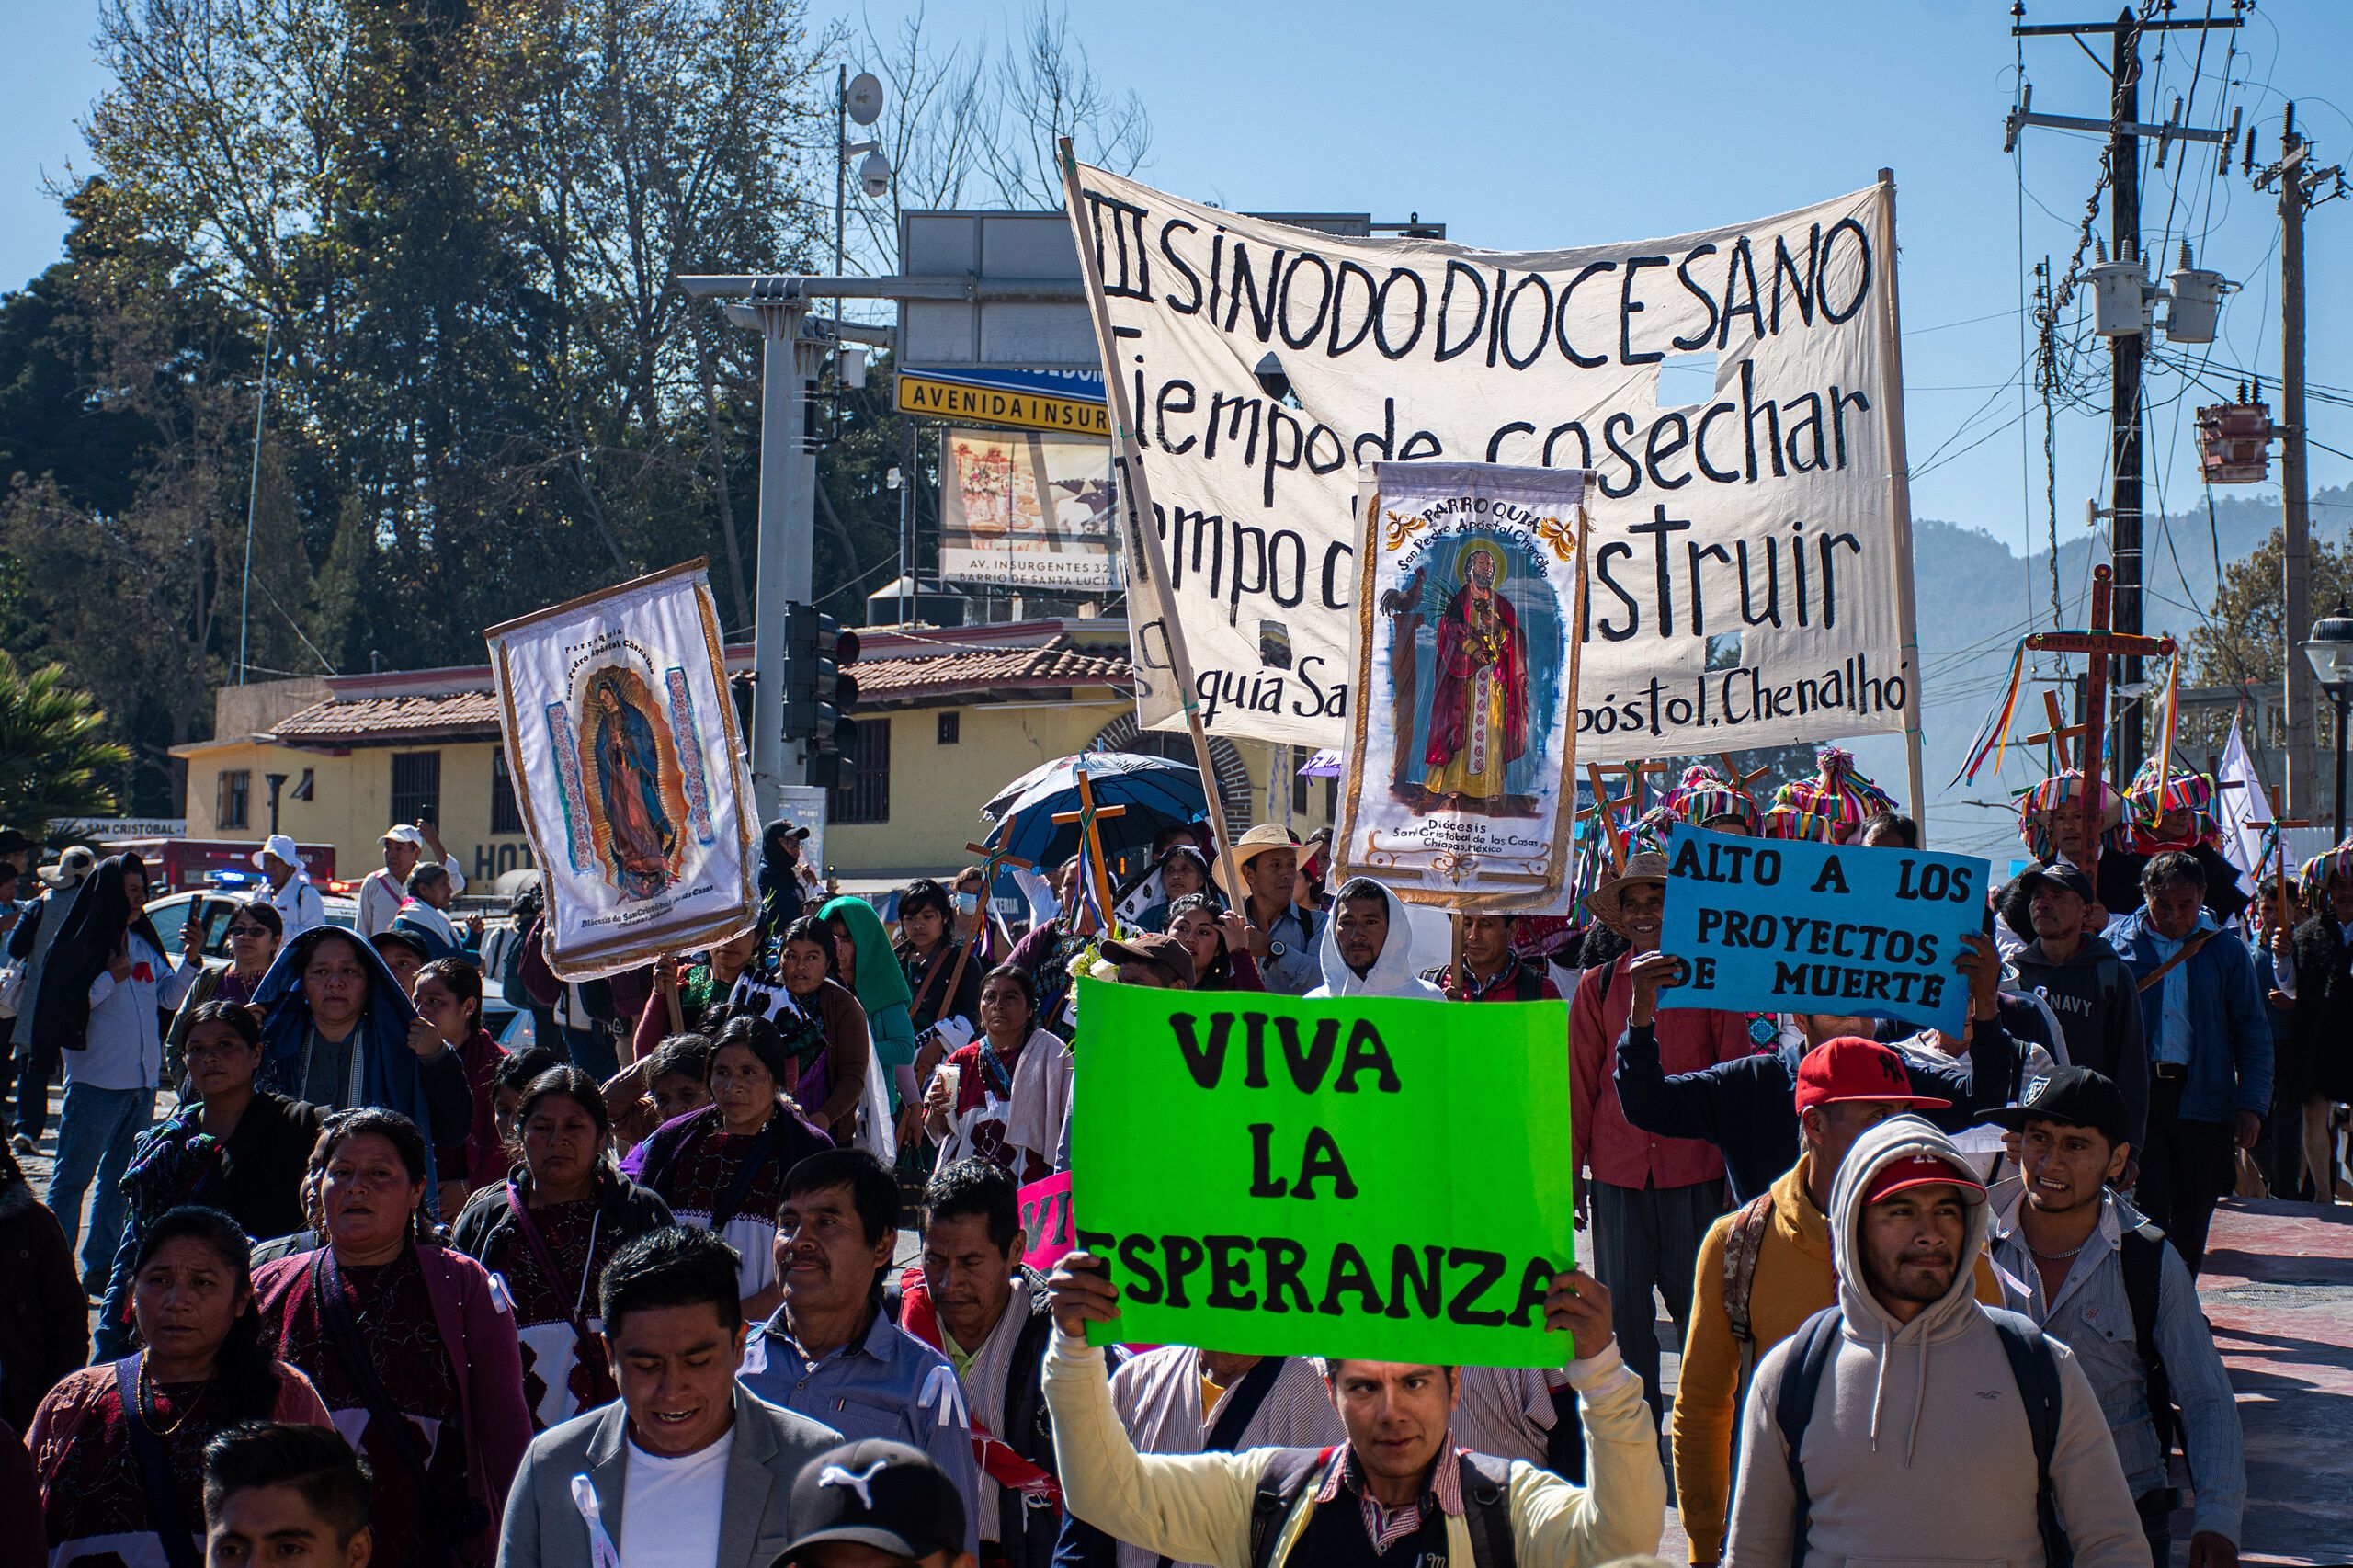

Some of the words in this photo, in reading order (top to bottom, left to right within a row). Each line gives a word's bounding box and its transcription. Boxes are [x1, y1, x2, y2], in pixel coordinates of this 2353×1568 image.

[1433, 218, 1871, 370] DIOCESANO
[913, 385, 1022, 418] AVENIDA
[1031, 401, 1107, 429] INSUR
[970, 560, 990, 570] AV.
[995, 561, 1089, 573] INSURGENTES
[1398, 551, 1418, 571] San
[1413, 524, 1451, 551] Pedro
[960, 574, 1007, 584] BARRIO
[1013, 574, 1027, 585] DE
[1031, 575, 1072, 585] SANTA
[1582, 504, 1861, 643] struir
[568, 655, 589, 680] Pedro
[87, 823, 108, 835] SAN
[1393, 827, 1416, 837] San
[1472, 833, 1485, 844] de
[1491, 835, 1506, 846] las
[1508, 835, 1539, 847] Casas
[475, 843, 533, 881] HOT
[1668, 838, 1781, 887] ALTO
[1811, 854, 1850, 894] A
[1895, 858, 1972, 903] LOS
[1697, 908, 1938, 967] PROYECTOS
[1771, 961, 1946, 1009] MUERTE
[2050, 994, 2093, 1017] NAVY
[1168, 1012, 1402, 1094] VIVA
[1247, 1123, 1358, 1200] LA
[1021, 1190, 1072, 1254] VI
